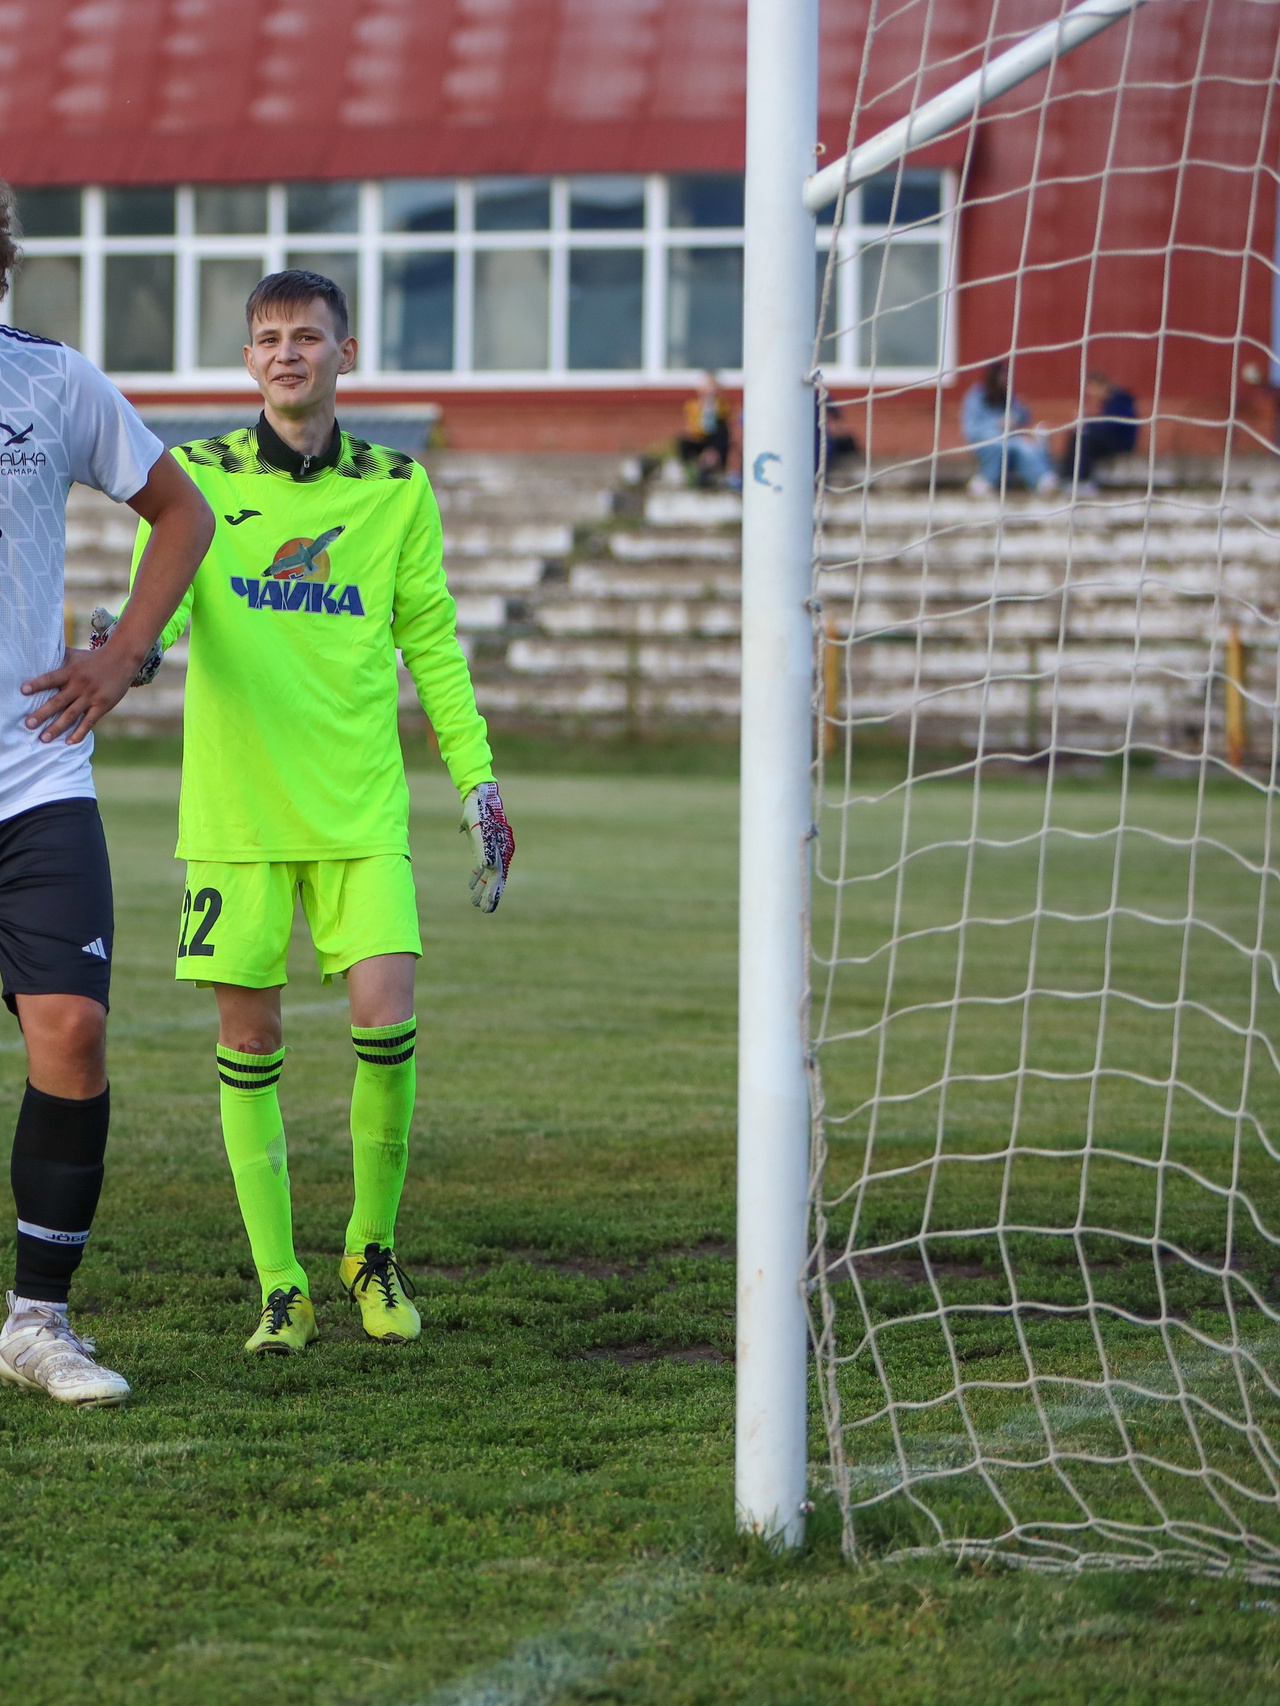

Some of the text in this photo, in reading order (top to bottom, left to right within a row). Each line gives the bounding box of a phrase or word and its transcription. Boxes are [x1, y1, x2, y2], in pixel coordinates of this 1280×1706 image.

[0, 468, 38, 476] САМАРА
[230, 572, 366, 617] ЧАЙКА
[45, 1233, 89, 1242] JÖGE
